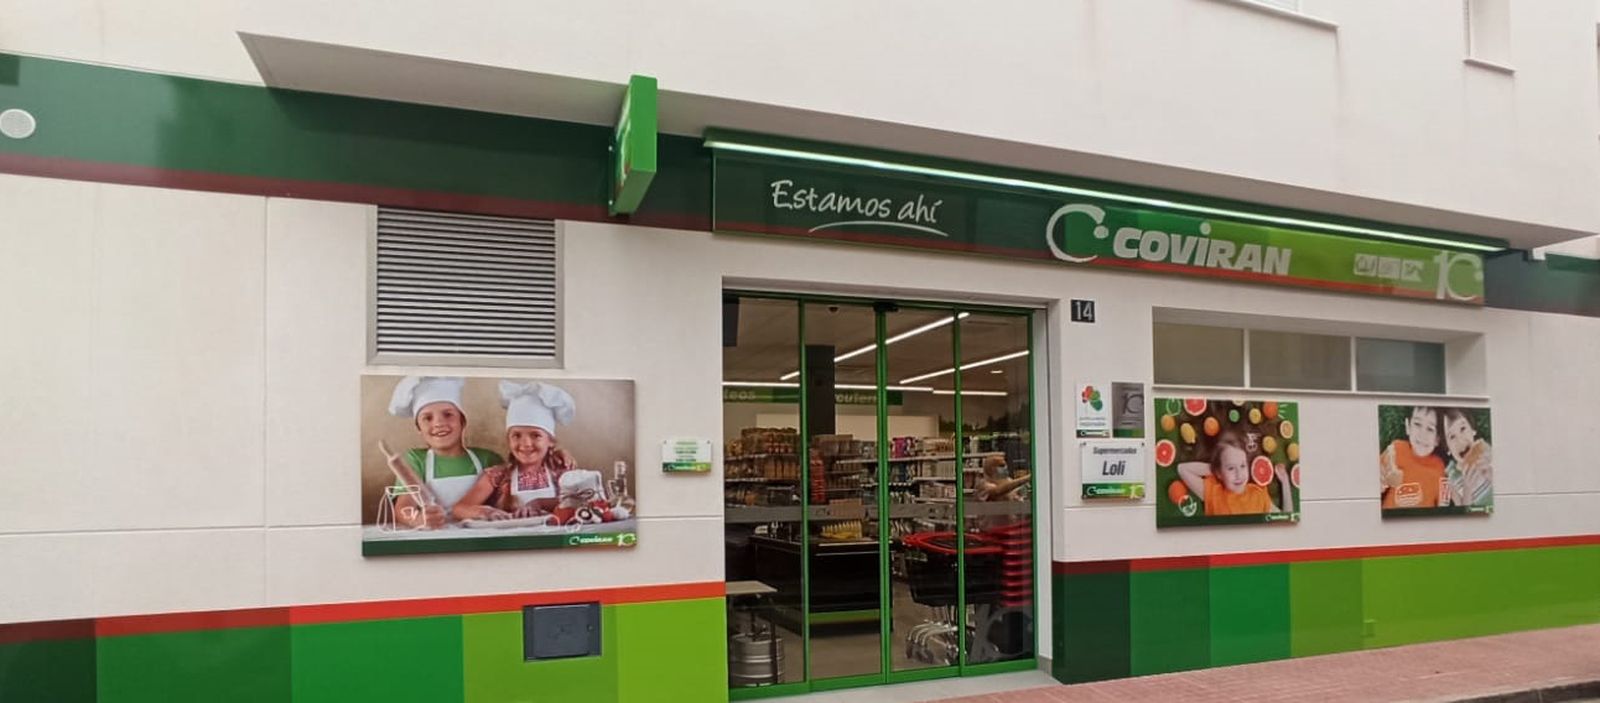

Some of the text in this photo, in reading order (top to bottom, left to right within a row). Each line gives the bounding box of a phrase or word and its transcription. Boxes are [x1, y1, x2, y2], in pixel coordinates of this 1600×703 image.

[771, 179, 943, 223] Estamos ahí
[1076, 301, 1093, 320] 14
[1102, 460, 1126, 476] Loli
